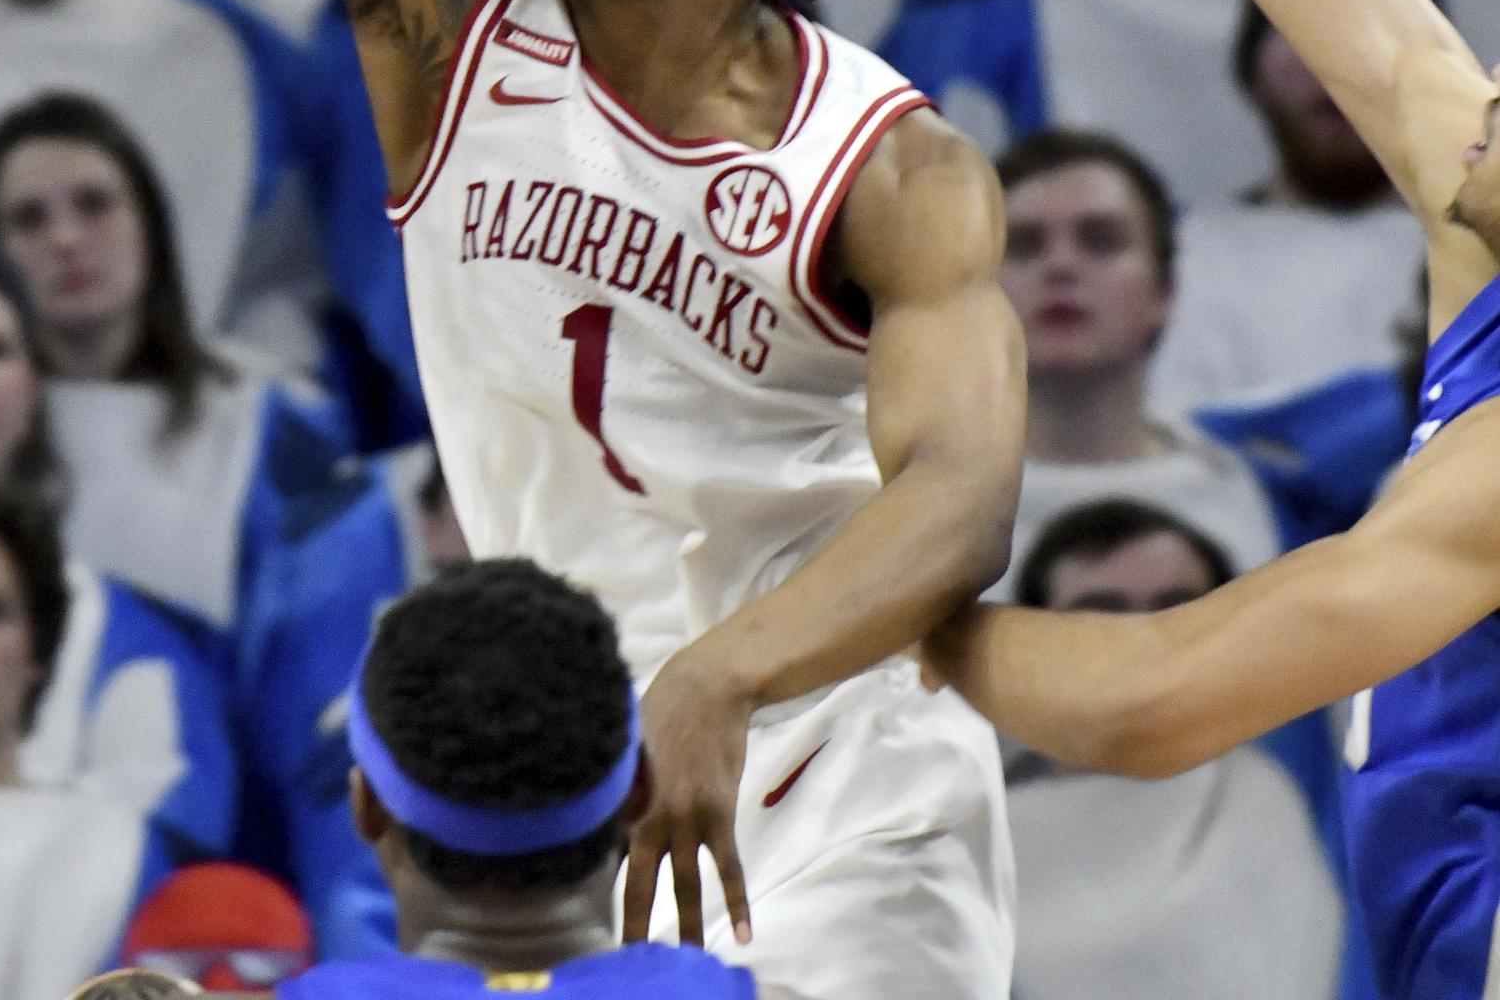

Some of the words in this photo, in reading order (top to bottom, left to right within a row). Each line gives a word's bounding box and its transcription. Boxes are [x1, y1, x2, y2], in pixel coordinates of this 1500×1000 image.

[461, 179, 778, 375] RAZORBACKS
[708, 168, 790, 252] SEC
[561, 303, 649, 497] 1
